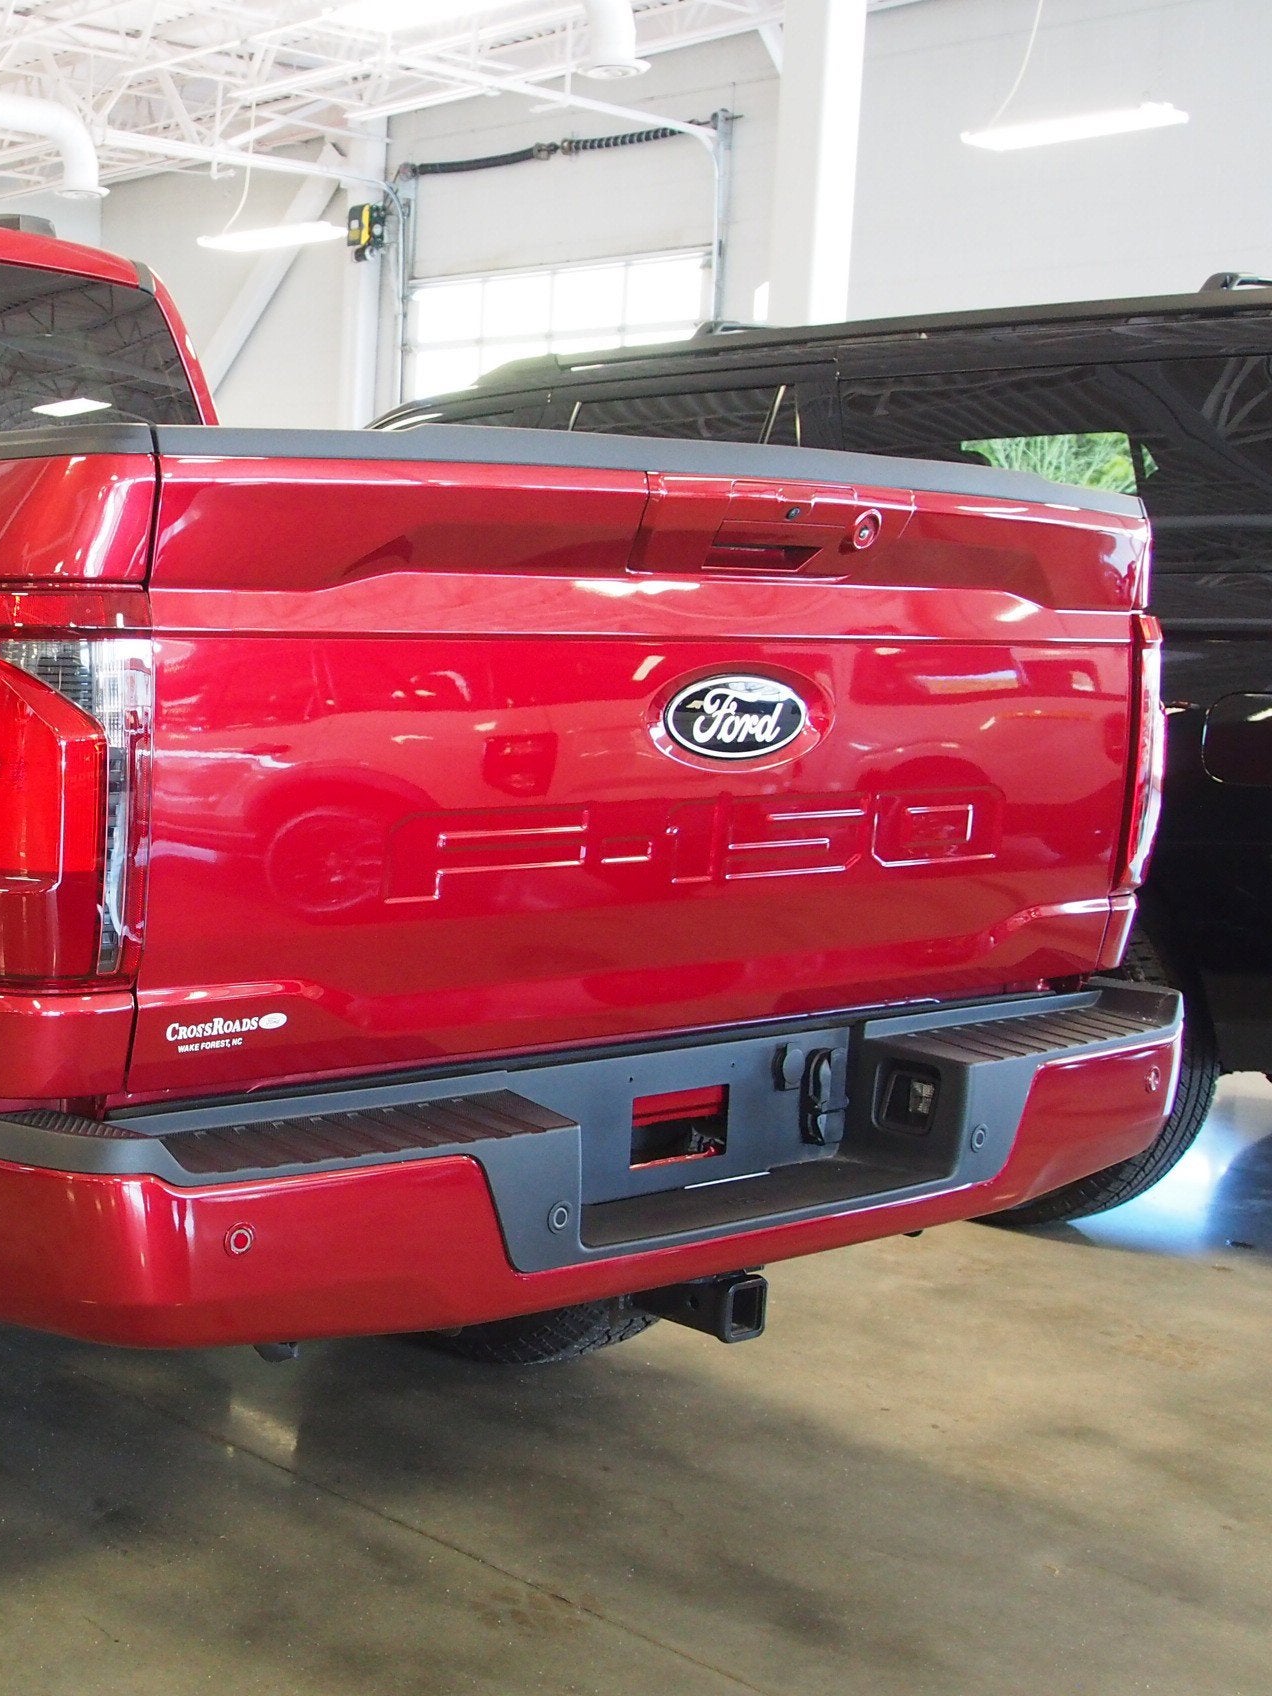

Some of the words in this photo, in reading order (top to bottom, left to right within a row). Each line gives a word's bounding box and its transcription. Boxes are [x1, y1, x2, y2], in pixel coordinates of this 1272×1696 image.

[692, 687, 788, 743] Ford
[384, 783, 1007, 904] F-150
[177, 1043, 200, 1053] WAKE
[200, 1038, 231, 1050] FOREST,
[232, 1037, 243, 1046] NC
